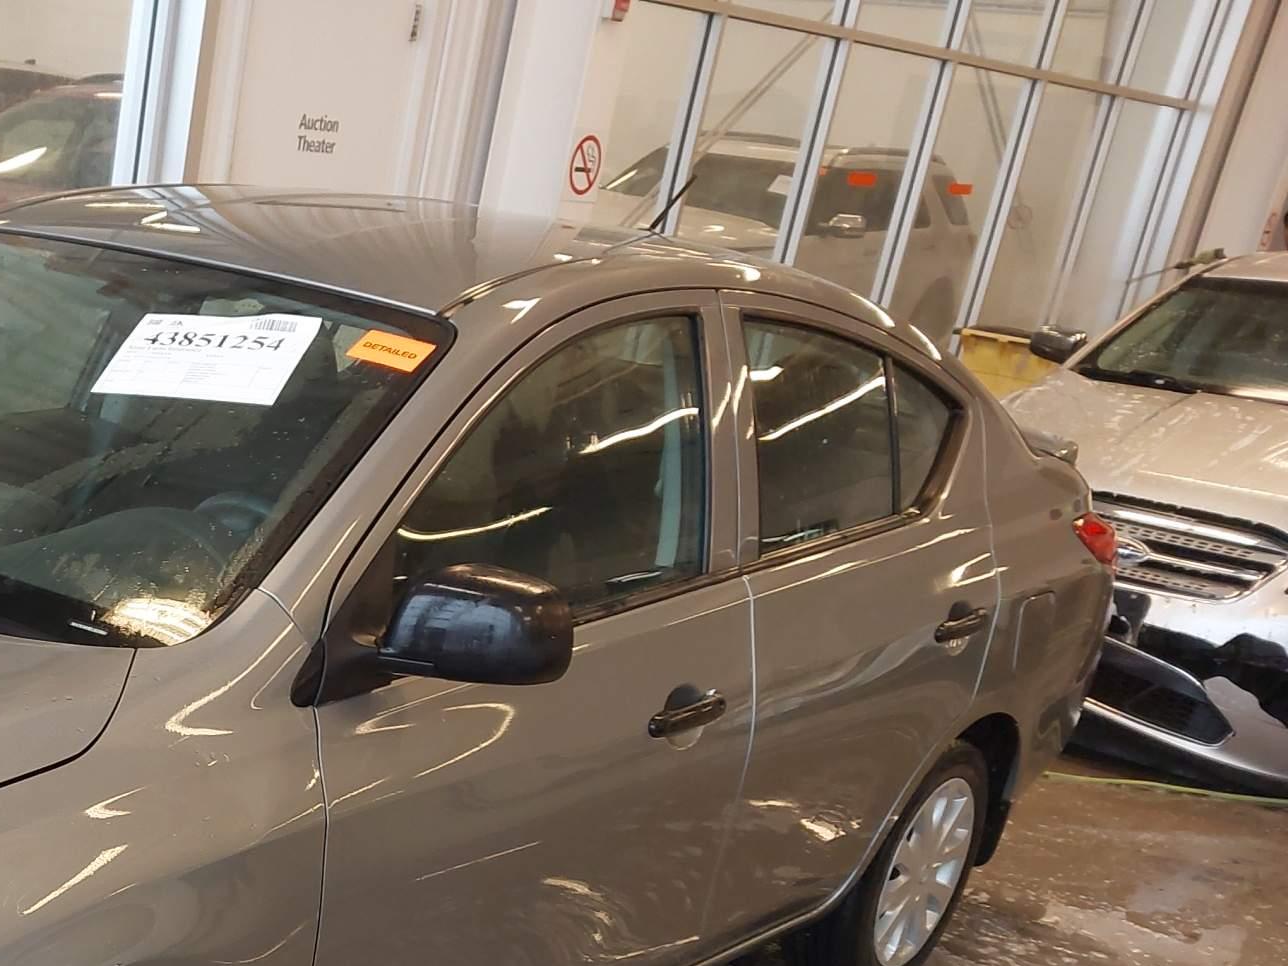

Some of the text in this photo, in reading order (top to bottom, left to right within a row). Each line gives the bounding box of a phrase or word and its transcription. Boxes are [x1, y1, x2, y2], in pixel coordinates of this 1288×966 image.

[298, 113, 340, 133] Auction
[297, 135, 336, 154] Theater
[144, 330, 285, 351] 43851254
[362, 340, 418, 360] DETAILED
